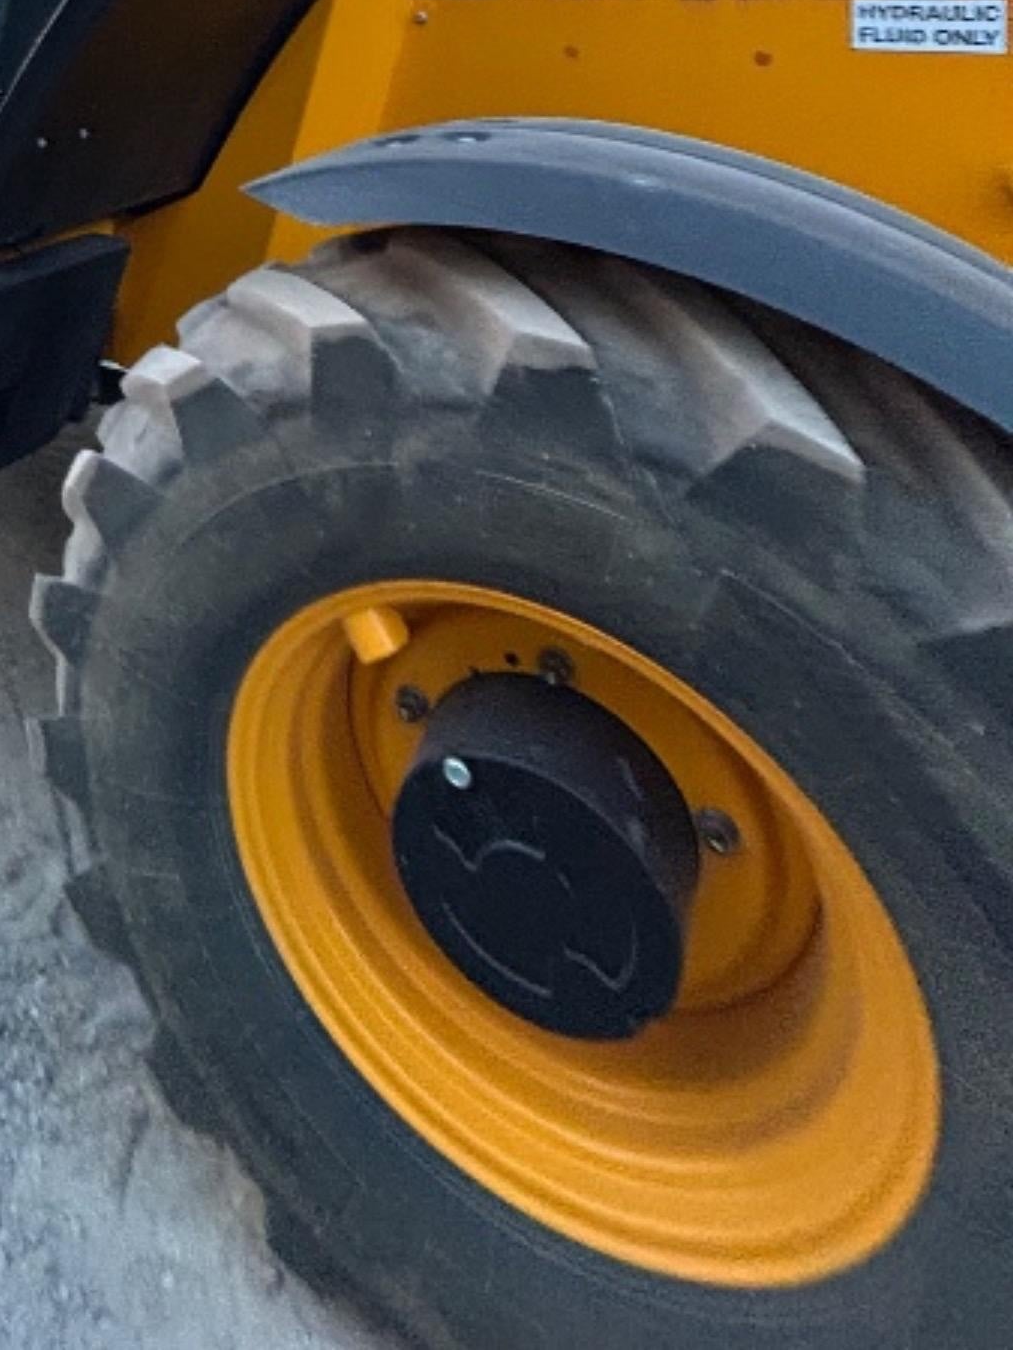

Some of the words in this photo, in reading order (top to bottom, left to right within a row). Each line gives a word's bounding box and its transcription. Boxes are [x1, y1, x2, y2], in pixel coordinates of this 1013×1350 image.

[858, 5, 1000, 22] HYDRAULIC
[859, 26, 927, 45] FLUID
[933, 28, 1000, 46] ONLY
